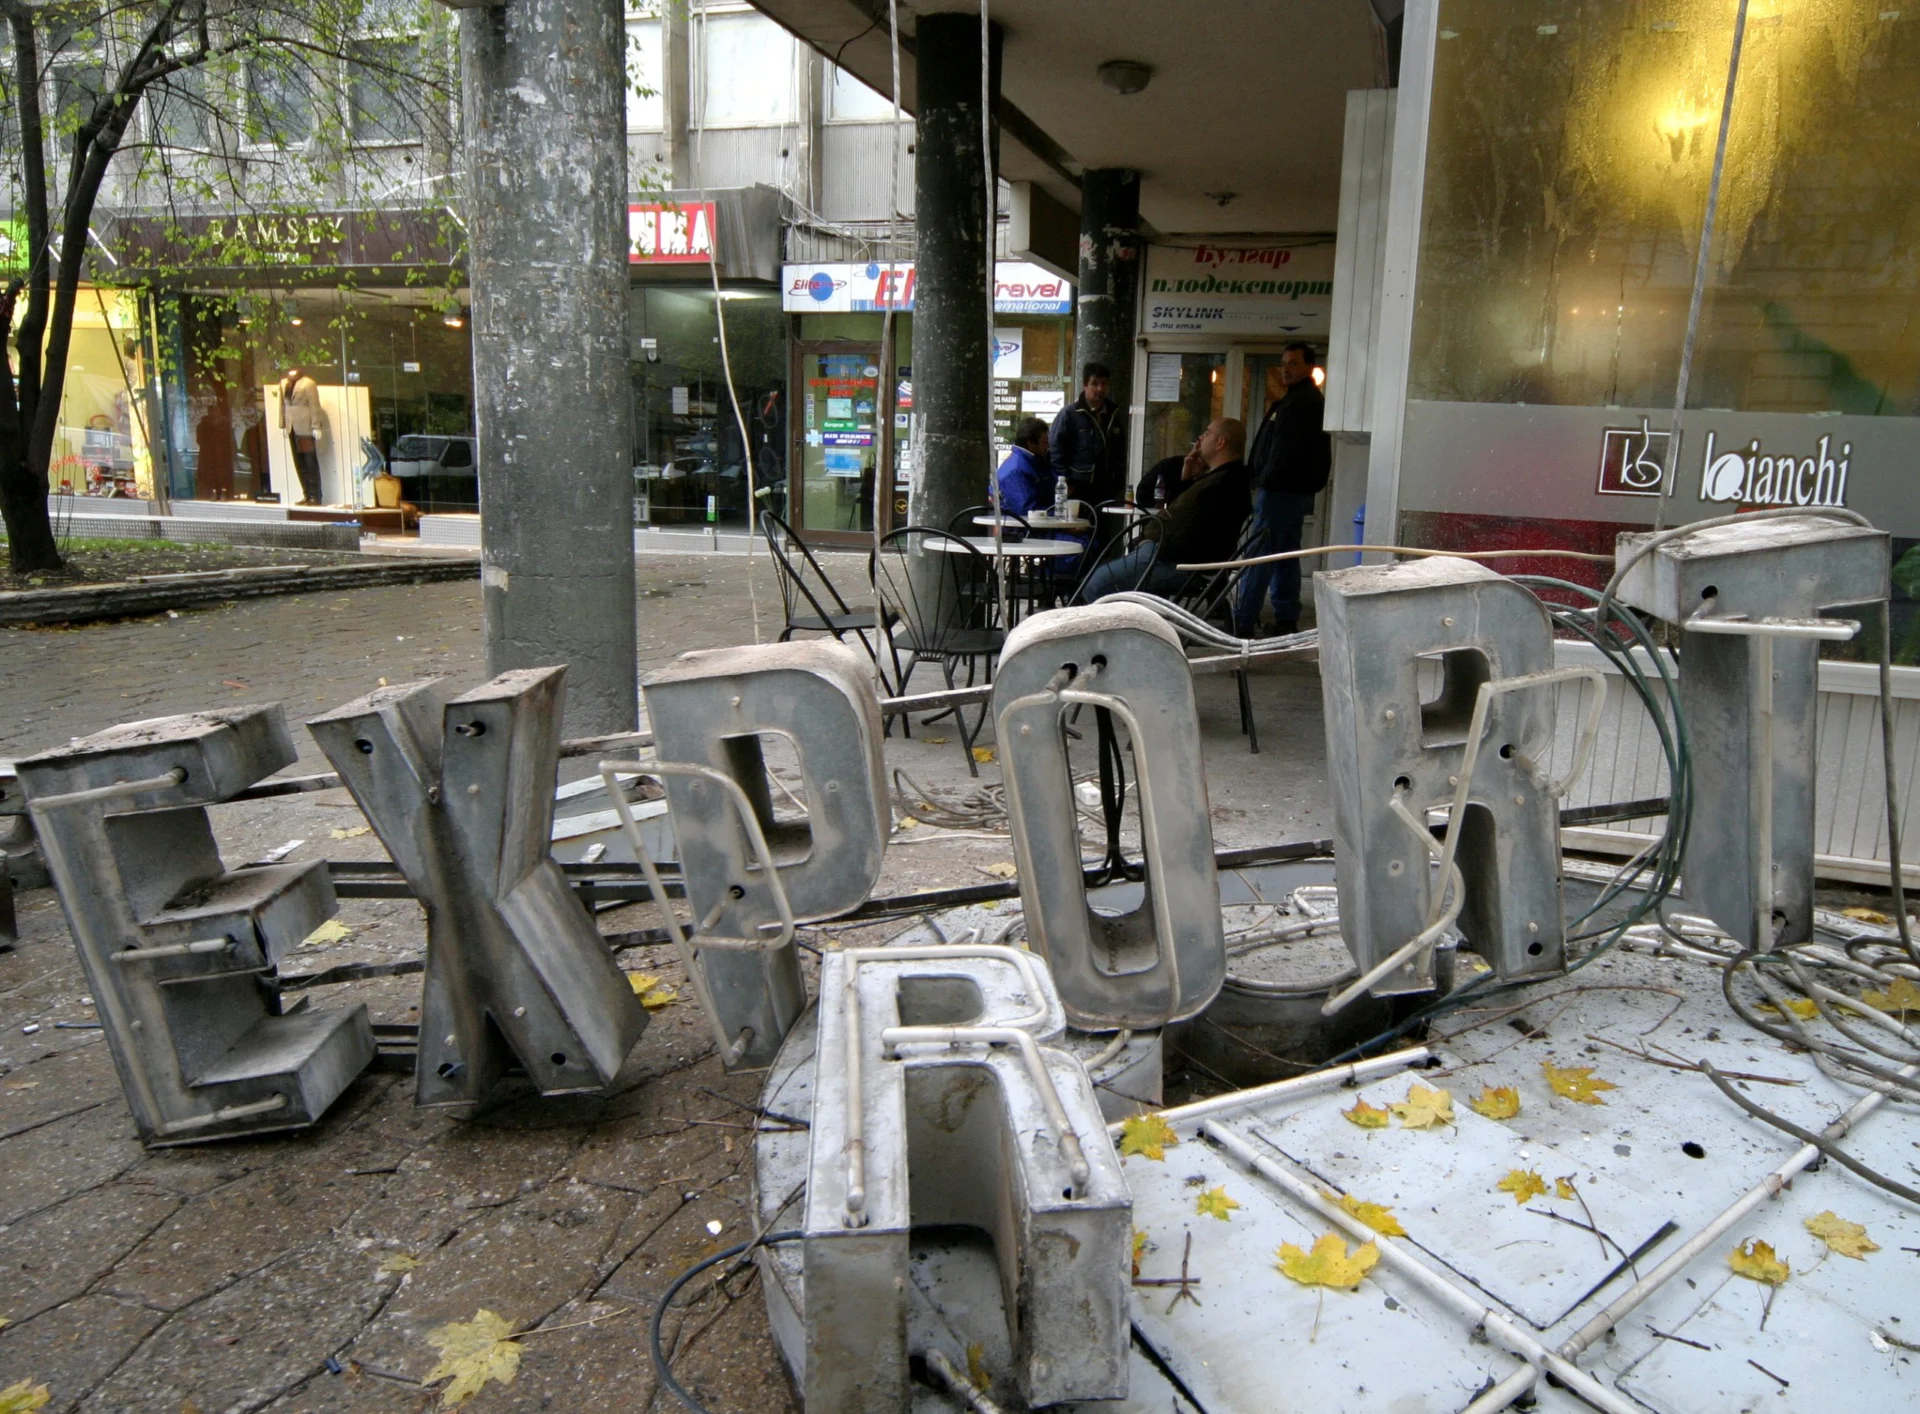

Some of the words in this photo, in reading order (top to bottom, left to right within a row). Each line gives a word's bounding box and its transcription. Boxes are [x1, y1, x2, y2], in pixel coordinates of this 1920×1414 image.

[209, 216, 344, 245] RAMSEY
[1195, 244, 1291, 269] Булгар
[994, 301, 1061, 311] ernational
[1152, 306, 1225, 320] SKYLINK
[1701, 431, 1851, 507] bianchi
[16, 505, 1889, 1148] EXPORT
